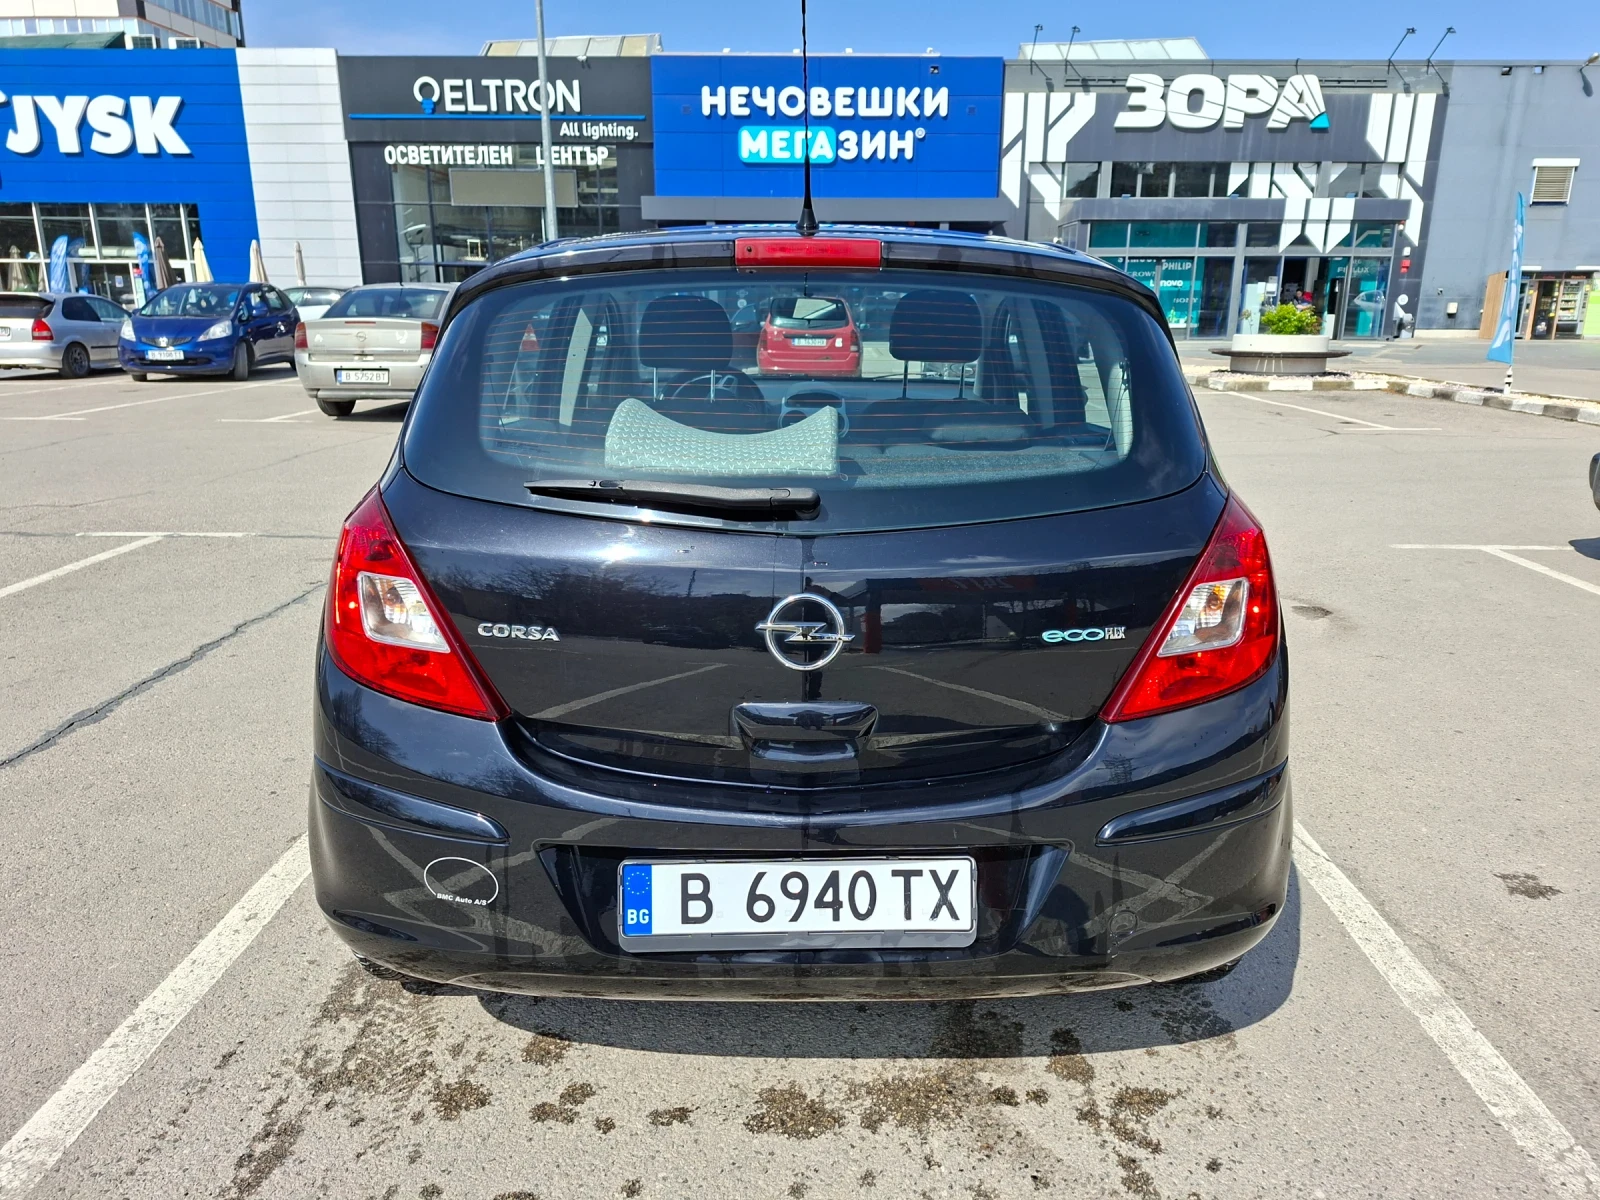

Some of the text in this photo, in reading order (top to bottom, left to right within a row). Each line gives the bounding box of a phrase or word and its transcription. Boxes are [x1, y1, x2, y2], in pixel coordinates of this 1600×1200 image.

[701, 85, 949, 118] НЕЧОВЕШКИ
[1113, 73, 1330, 129] ЗОРА
[6, 94, 191, 155] JYSK
[559, 122, 639, 141] All lighting.
[384, 145, 513, 166] ОСВЕТИТЕЛЕН
[1162, 262, 1192, 271] PHILIP
[1149, 279, 1184, 287] Lnovo
[477, 623, 560, 642] CORSA
[436, 892, 454, 901] BMC
[455, 896, 473, 904] Auto
[680, 869, 961, 925] B 6940 TX
[627, 909, 650, 925] BG
